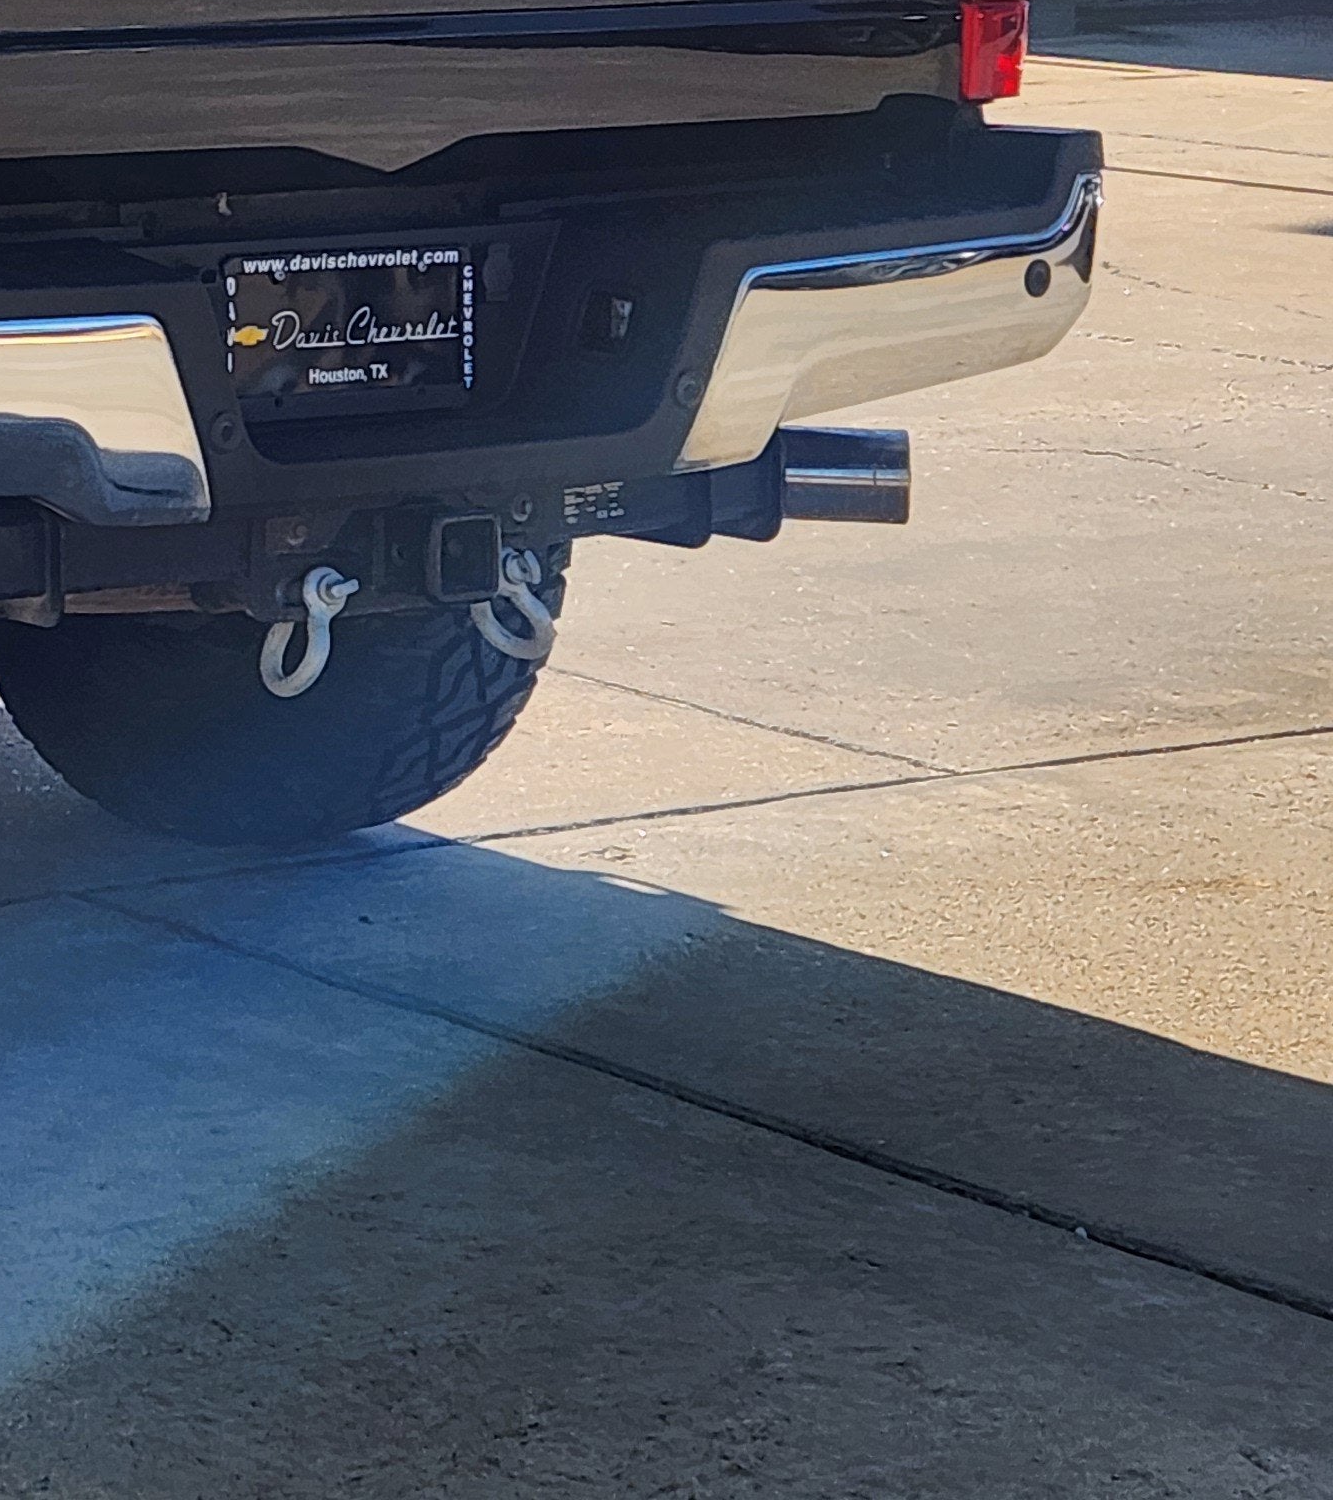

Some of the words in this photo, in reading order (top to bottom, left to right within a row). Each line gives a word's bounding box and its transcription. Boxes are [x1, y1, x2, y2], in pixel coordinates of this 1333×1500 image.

[243, 250, 459, 274] www.davischevrolet.com
[271, 310, 346, 350] Davis
[346, 306, 460, 344] Chevrolet
[462, 265, 473, 389] CHEVROLET
[308, 367, 368, 385] Houston,
[369, 363, 389, 379] TX
